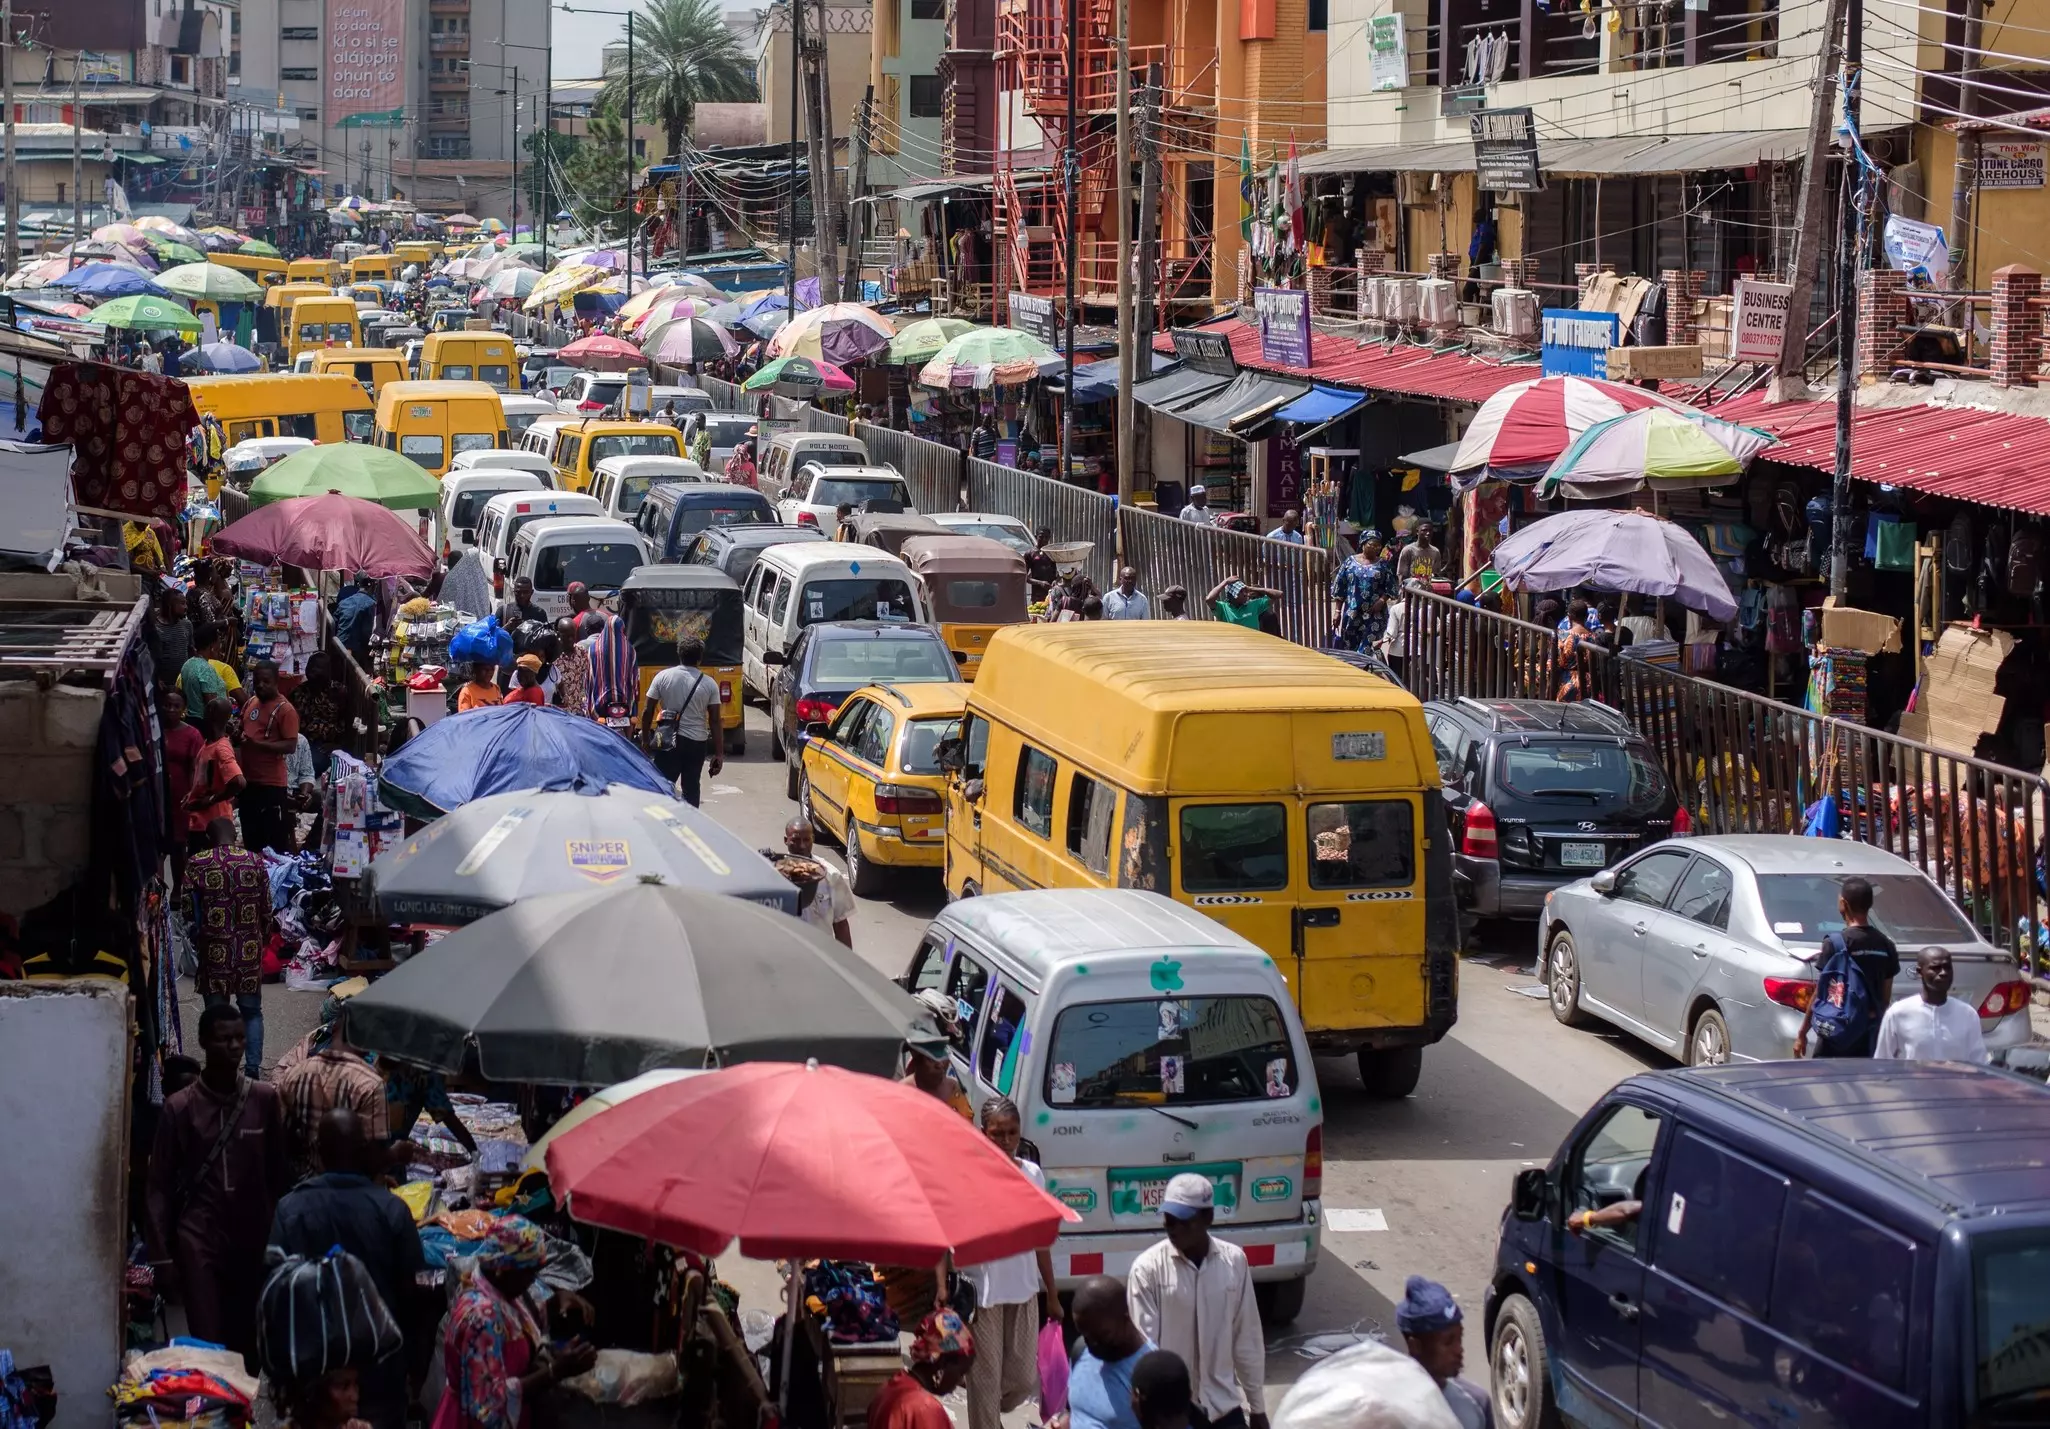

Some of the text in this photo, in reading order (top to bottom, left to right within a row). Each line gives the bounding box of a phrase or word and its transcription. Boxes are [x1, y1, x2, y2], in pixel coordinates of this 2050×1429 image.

[334, 70, 372, 81] ohun
[2021, 144, 2041, 152] Way
[2011, 158, 2043, 170] CARGO
[1743, 292, 1790, 310] BUSINESS
[1746, 312, 1782, 329] CENTRE
[828, 443, 850, 451] MODEL
[570, 842, 625, 853] SNIPER
[394, 901, 423, 912] LONG
[424, 902, 465, 916] LASTING
[1253, 1115, 1300, 1127] EVERY
